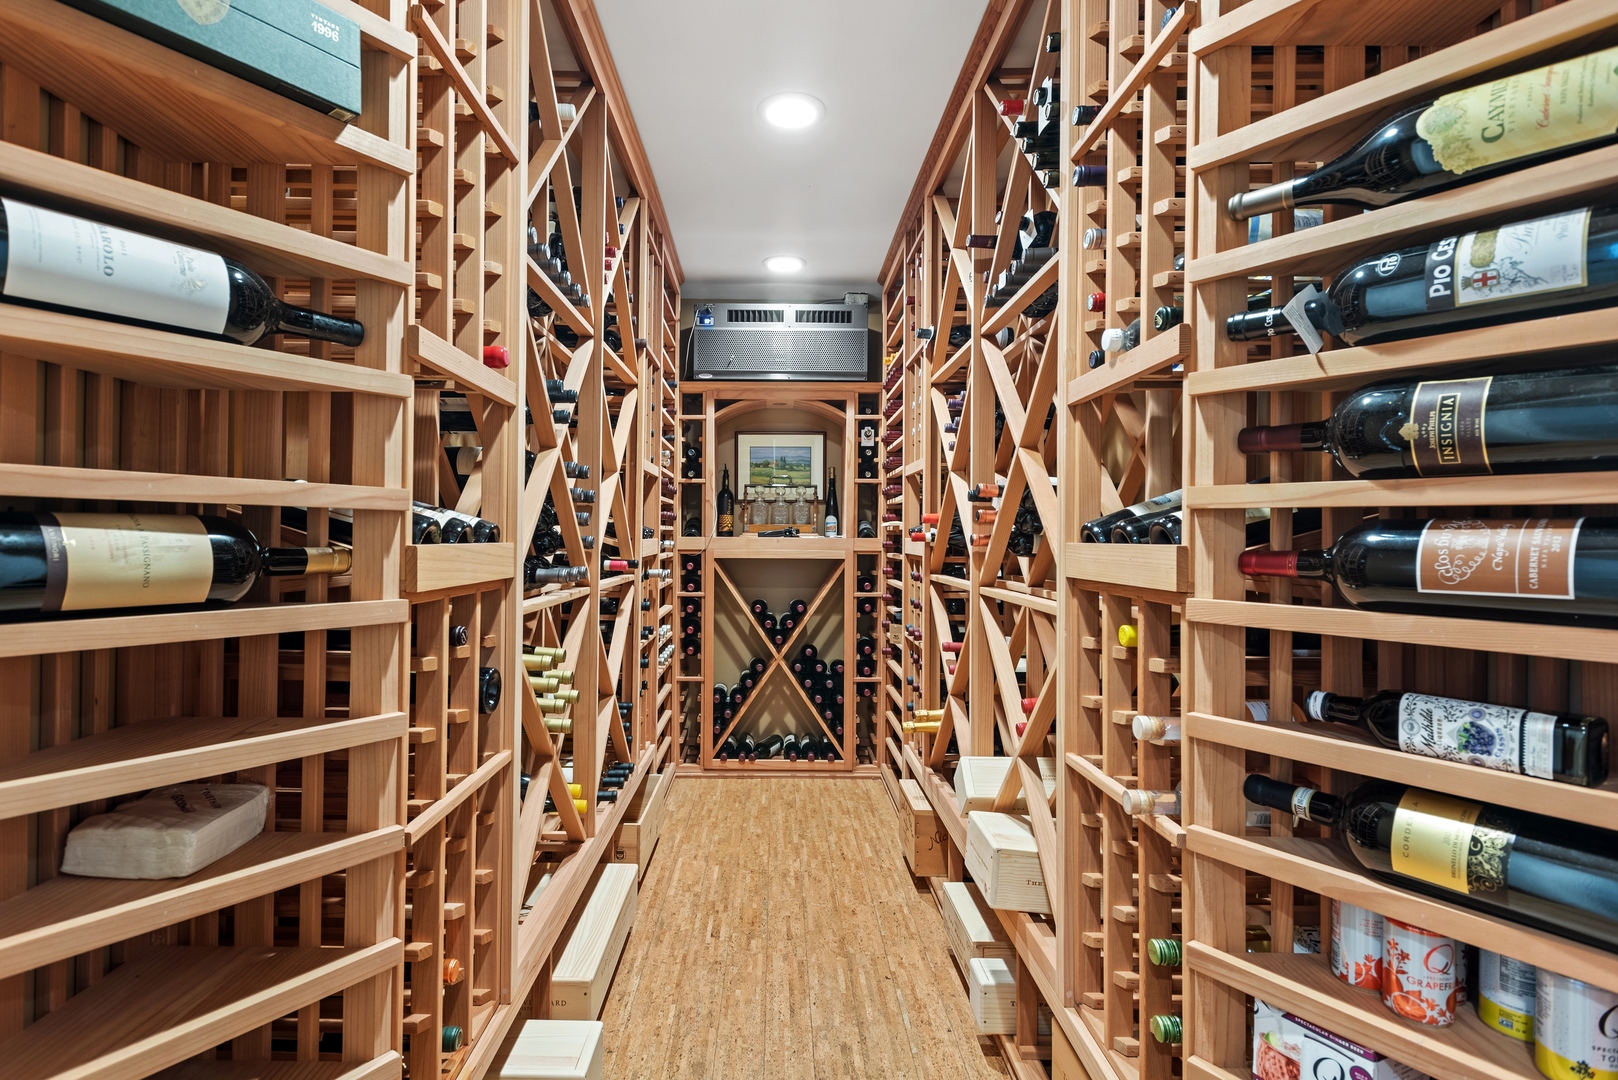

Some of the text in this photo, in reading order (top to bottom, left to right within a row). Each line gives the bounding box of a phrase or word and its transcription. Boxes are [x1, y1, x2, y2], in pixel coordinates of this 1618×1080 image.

[310, 12, 340, 31] VINTAGE
[311, 20, 339, 42] 1996
[1429, 264, 1452, 298] PIO
[1428, 410, 1437, 449] JOSEPH PHELPS
[1440, 397, 1455, 460] INSIGNIA
[47, 527, 60, 562] ANTINORI
[1491, 546, 1509, 571] Napa
[1541, 550, 1549, 568] NAPA
[1551, 535, 1563, 553] 2012
[140, 535, 151, 589] PASSIGNANO
[1529, 546, 1540, 590] CABERNET
[1419, 707, 1439, 758] Mathilde
[1494, 727, 1506, 758] CASSIS
[1402, 801, 1420, 858] CORDEA
[1423, 943, 1455, 976] Q
[1406, 975, 1456, 992] GRAPEFR
[1294, 1016, 1365, 1055] SPECTACULAR GINGER BEER
[1600, 1055, 1618, 1064] TO
